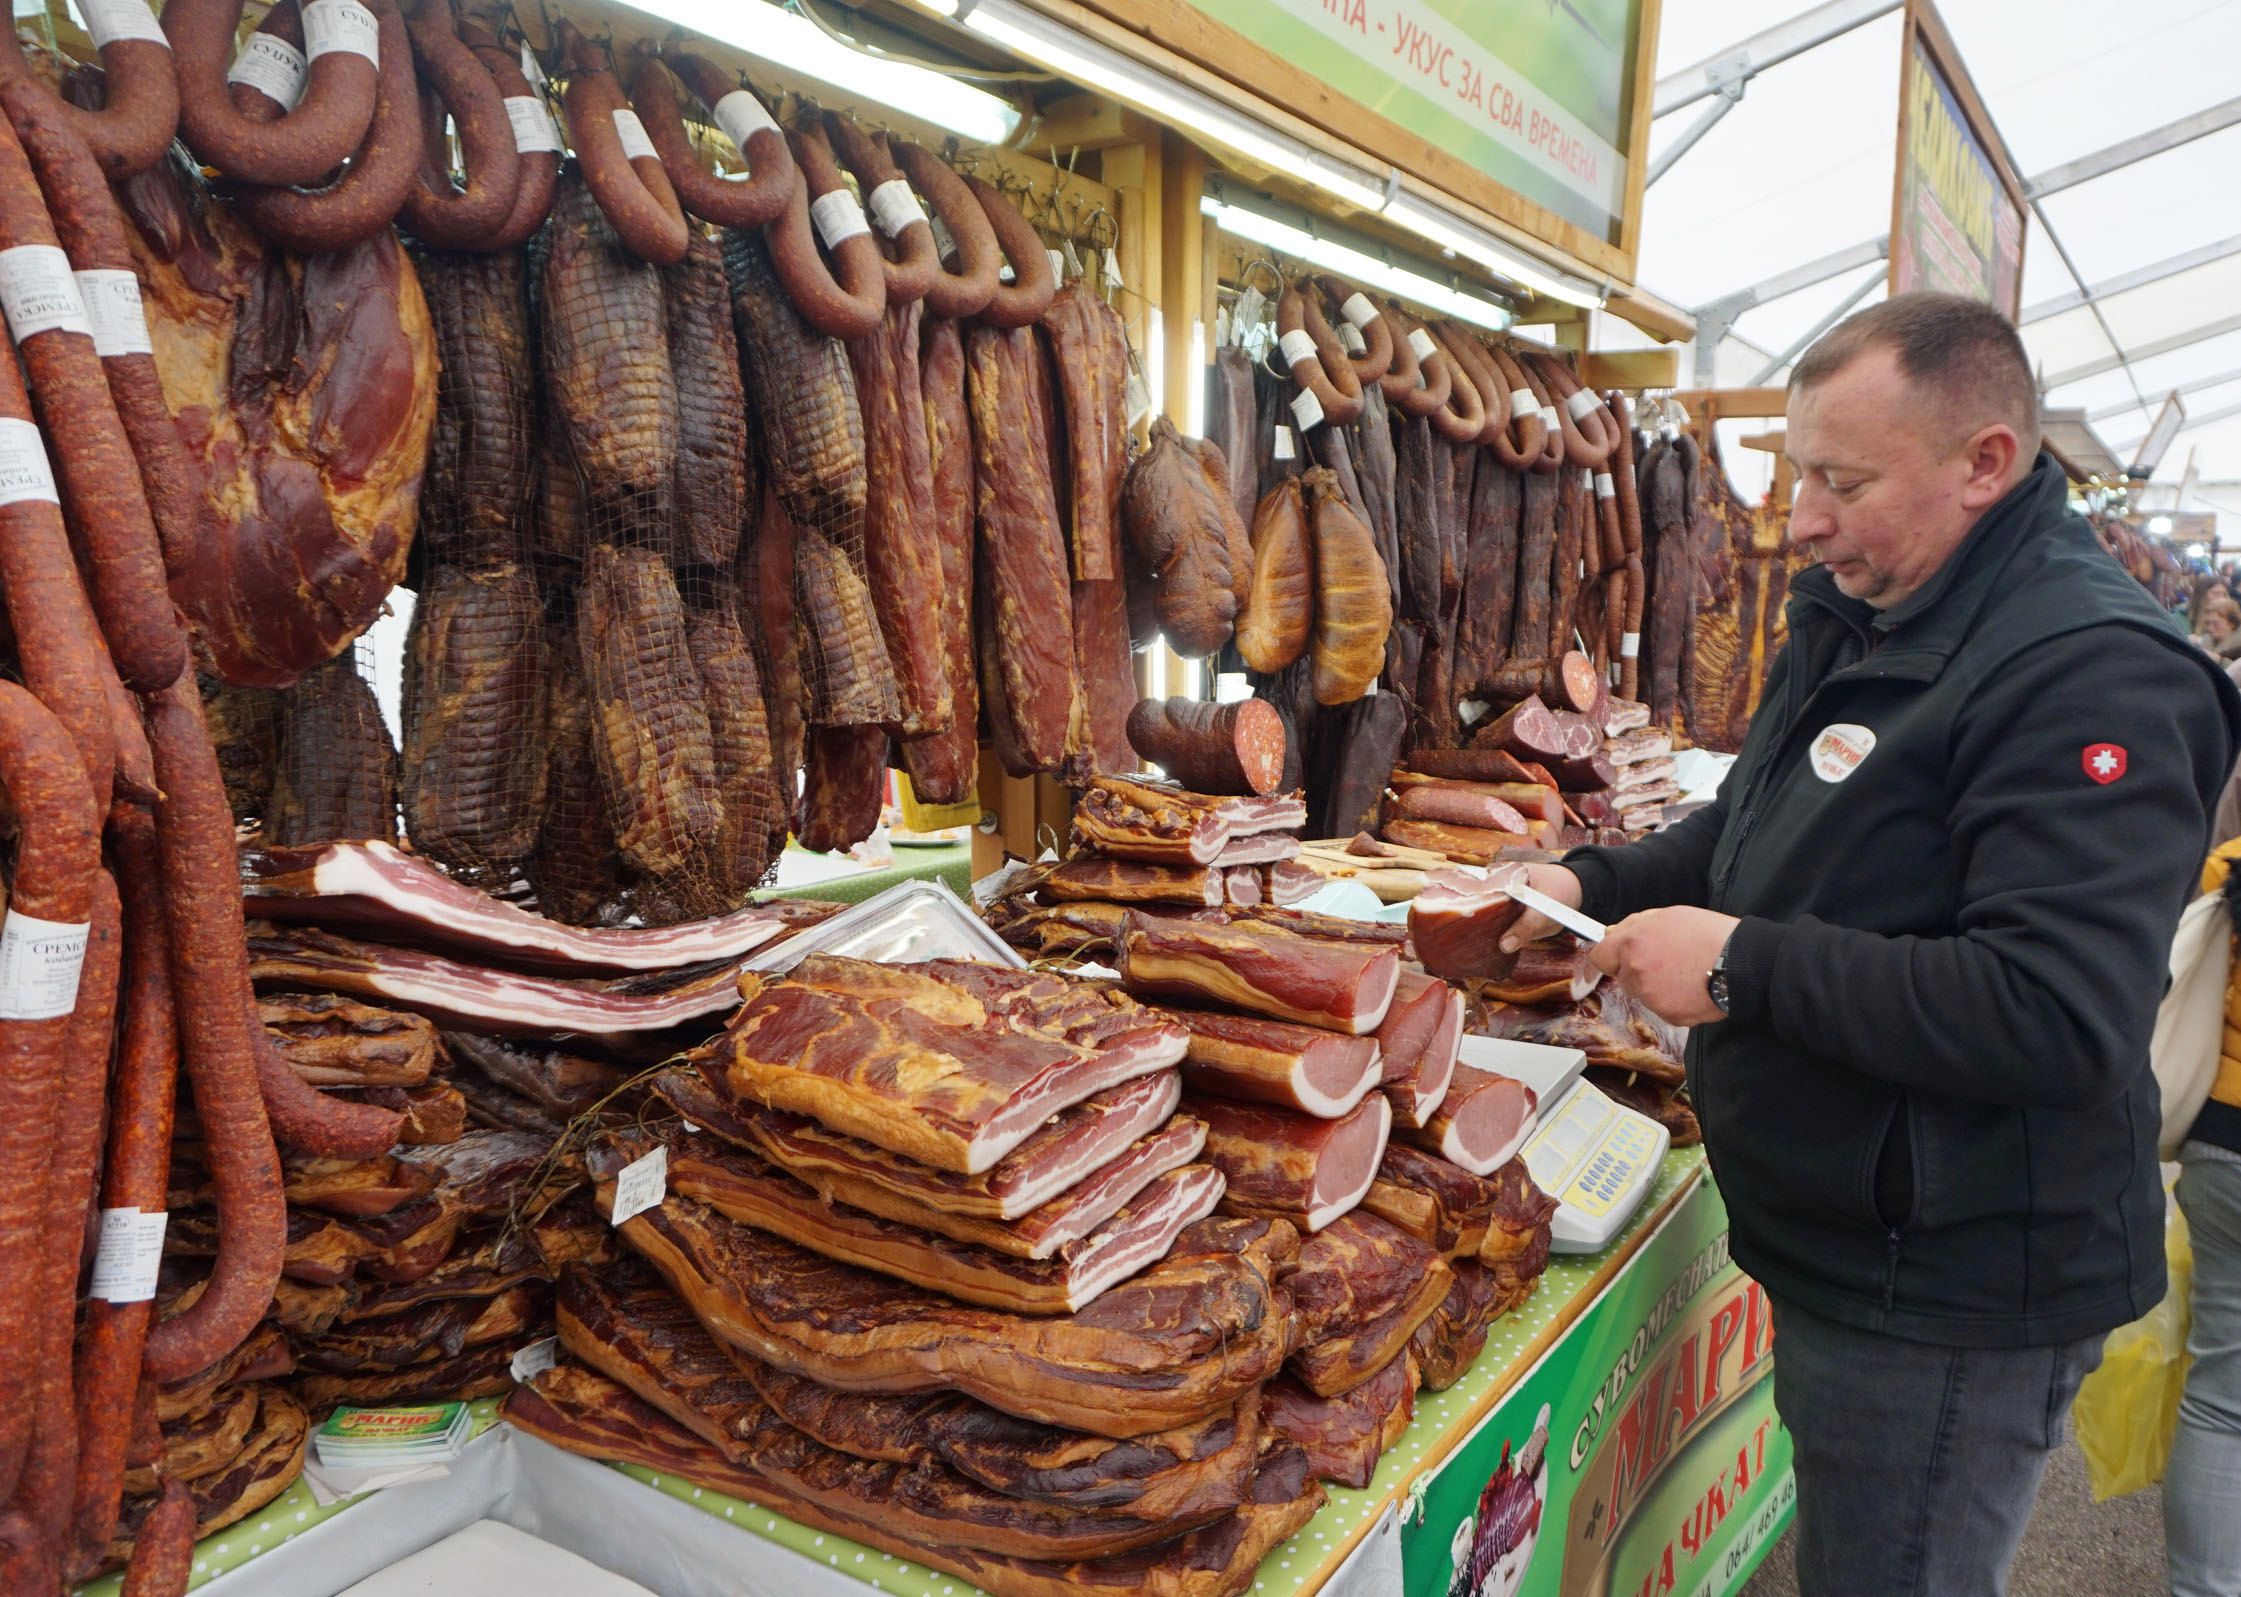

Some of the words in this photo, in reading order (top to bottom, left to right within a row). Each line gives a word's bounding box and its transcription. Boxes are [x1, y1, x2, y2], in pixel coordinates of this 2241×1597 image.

[253, 43, 301, 75] СУЦУК
[1393, 12, 1454, 87] УКУС
[1457, 59, 1482, 108] ЗА
[1489, 82, 1523, 136] СВА
[1528, 109, 1597, 185] ВРЕМЕНА
[1570, 1231, 1733, 1471] СУВОМЕСНАТ
[1602, 1280, 1776, 1547] МАРИ
[1758, 1495, 1778, 1536] 469
